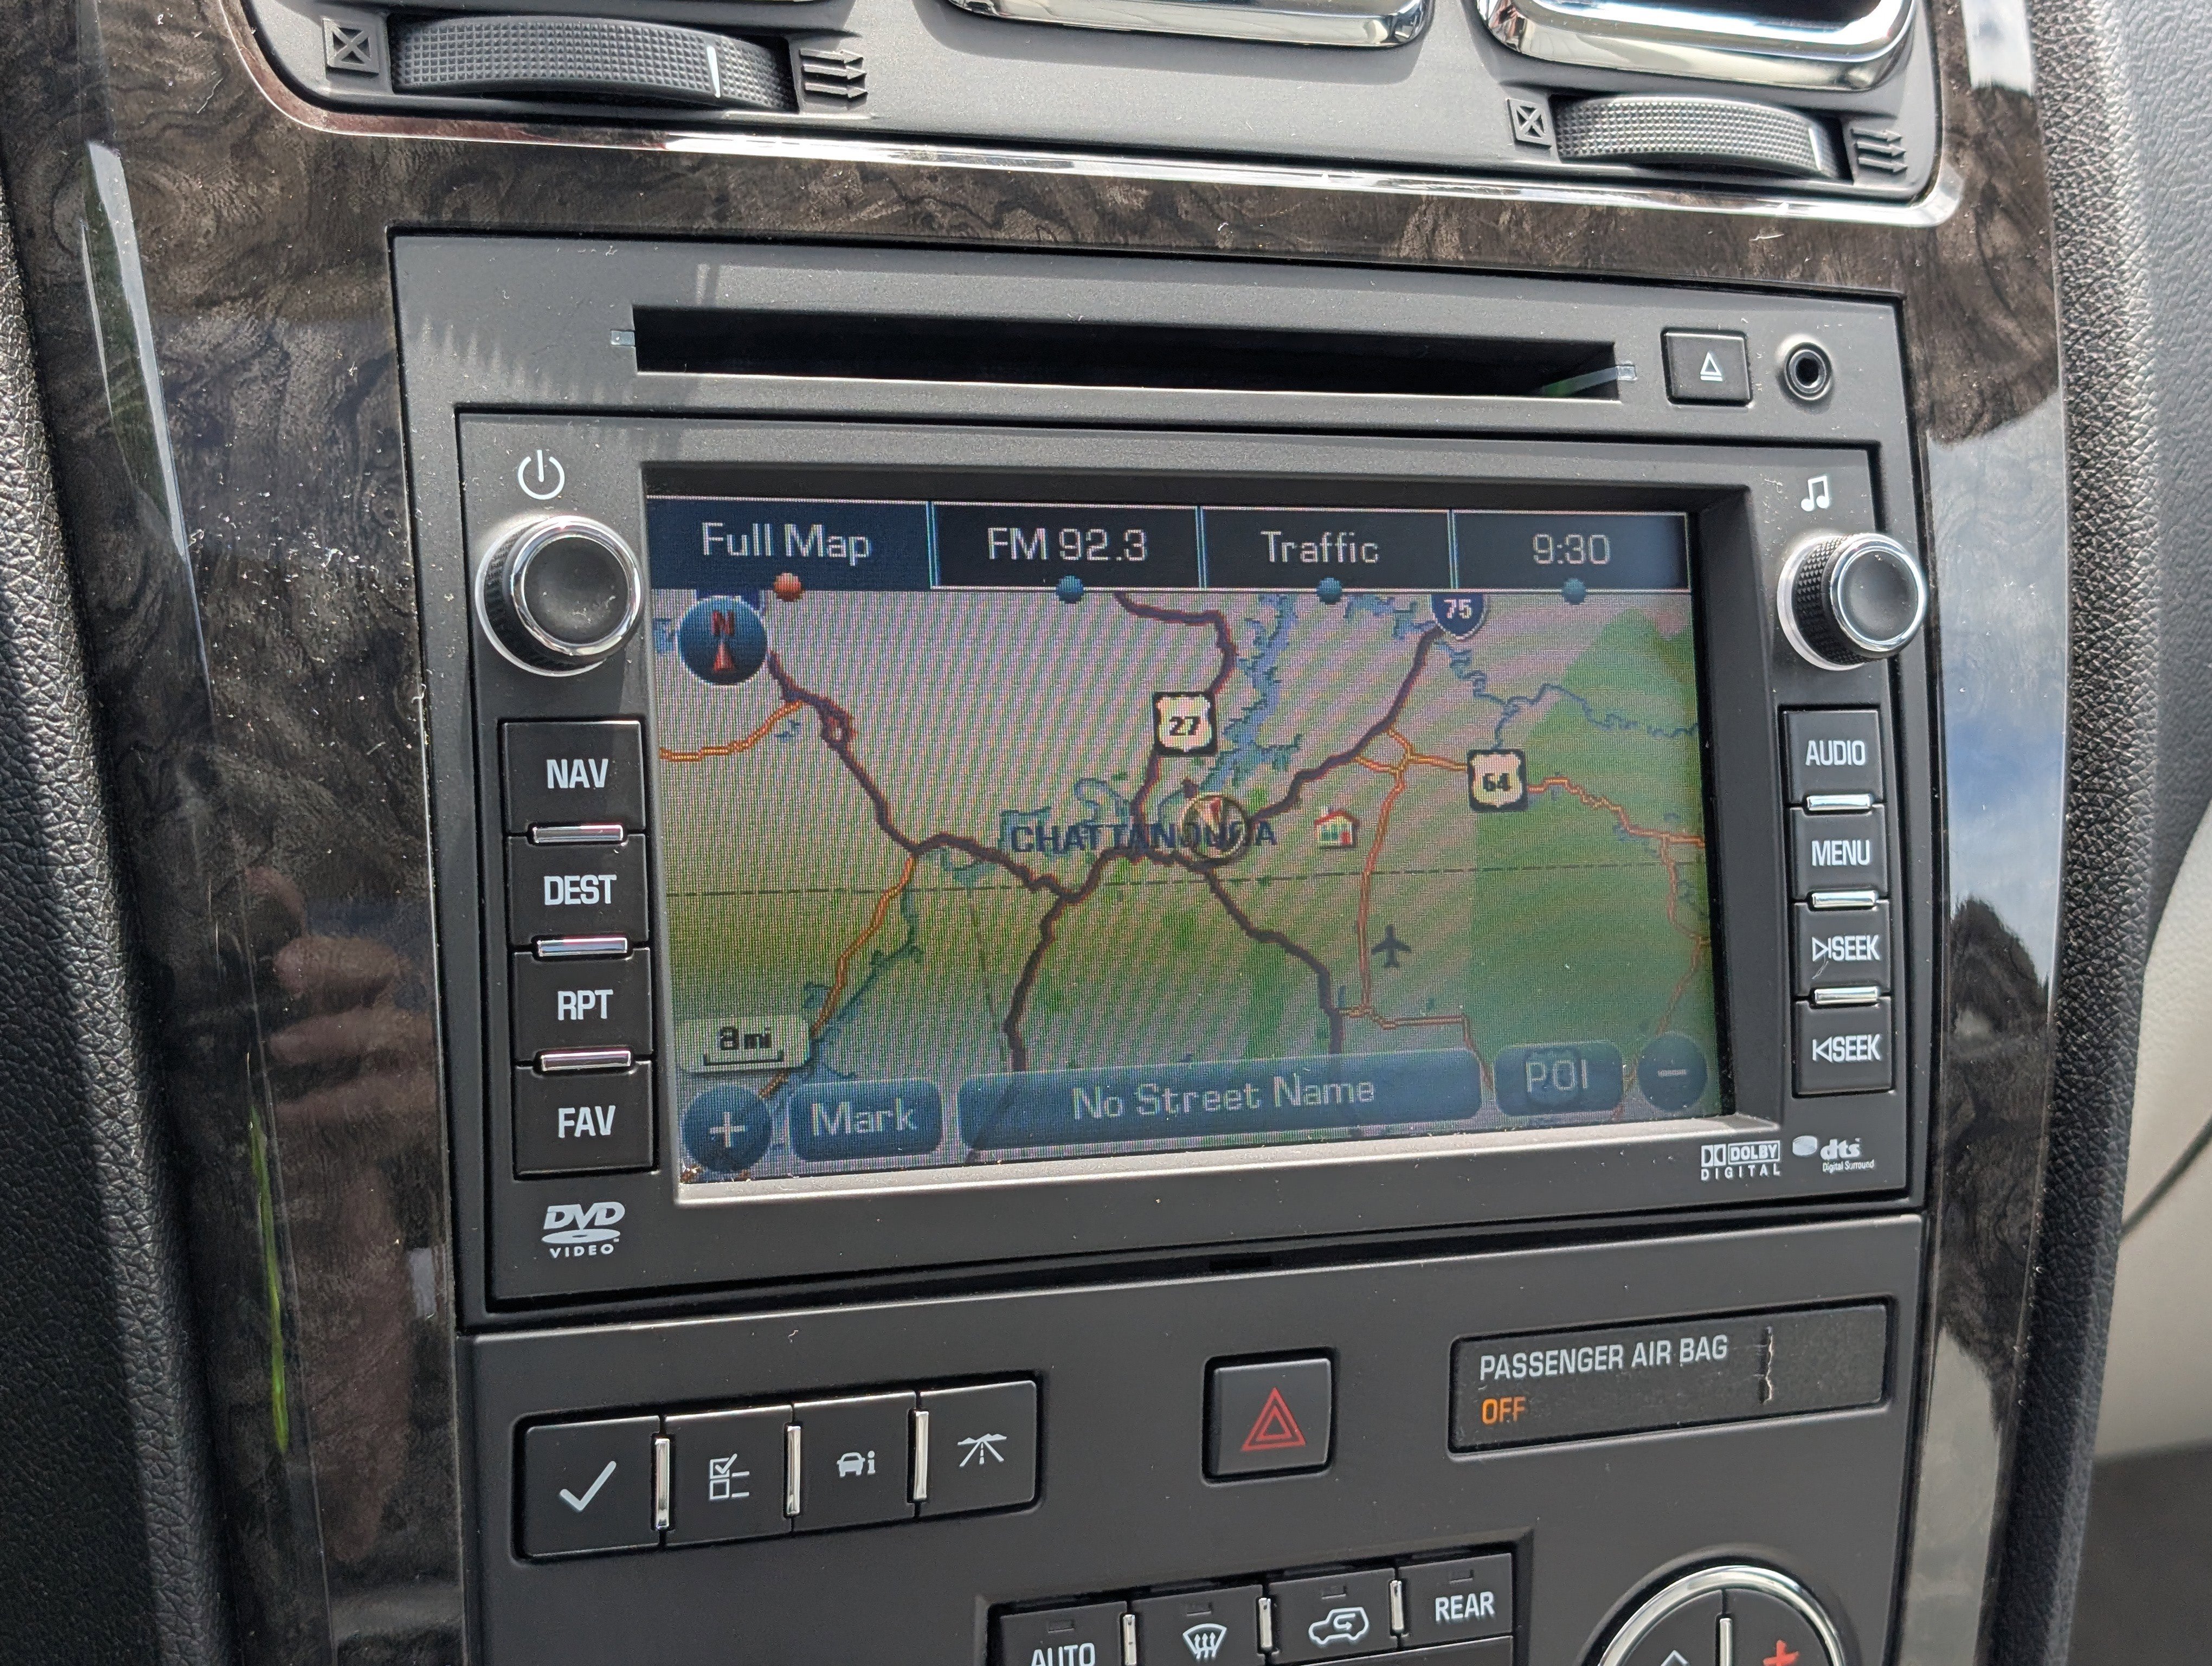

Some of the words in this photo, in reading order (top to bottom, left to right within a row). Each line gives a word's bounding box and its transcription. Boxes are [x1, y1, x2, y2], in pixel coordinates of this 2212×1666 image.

[702, 522, 771, 556] Full
[785, 524, 872, 567] Map
[988, 527, 1050, 560] FM
[1059, 528, 1147, 562] 92.3
[1260, 530, 1380, 565] Traffic
[1532, 534, 1611, 565] 9:30
[710, 610, 736, 637] N
[1443, 599, 1472, 619] 75
[1169, 716, 1201, 736] 27
[1805, 740, 1866, 766] AUDIO
[546, 758, 609, 789] NAV
[1482, 772, 1512, 792] 64
[1811, 840, 1871, 866] MENU
[544, 874, 617, 906] DEST
[1832, 934, 1882, 962] SEEK
[557, 989, 614, 1021] RPT
[743, 1027, 773, 1049] mi
[1832, 1034, 1882, 1063] SEEK
[1526, 1059, 1588, 1093] POI
[1073, 1085, 1124, 1120] No
[1136, 1082, 1262, 1117] Street
[1273, 1072, 1376, 1108] Name
[558, 1105, 616, 1138] FAV
[812, 1098, 918, 1138] Mark
[1730, 1144, 1777, 1162] DOLBY
[1820, 1139, 1861, 1161] dts
[1701, 1163, 1781, 1181] DIGITAL
[1822, 1161, 1844, 1174] Digital
[543, 1201, 625, 1230] DVD
[549, 1243, 614, 1259] VIDEO
[1479, 1344, 1624, 1382] PASSENGER
[1630, 1340, 1672, 1369] AIR
[1680, 1333, 1729, 1364] BAG
[1481, 1395, 1527, 1426] OFF
[1435, 1591, 1495, 1623] REAR
[1029, 1642, 1096, 1666] AUTO
